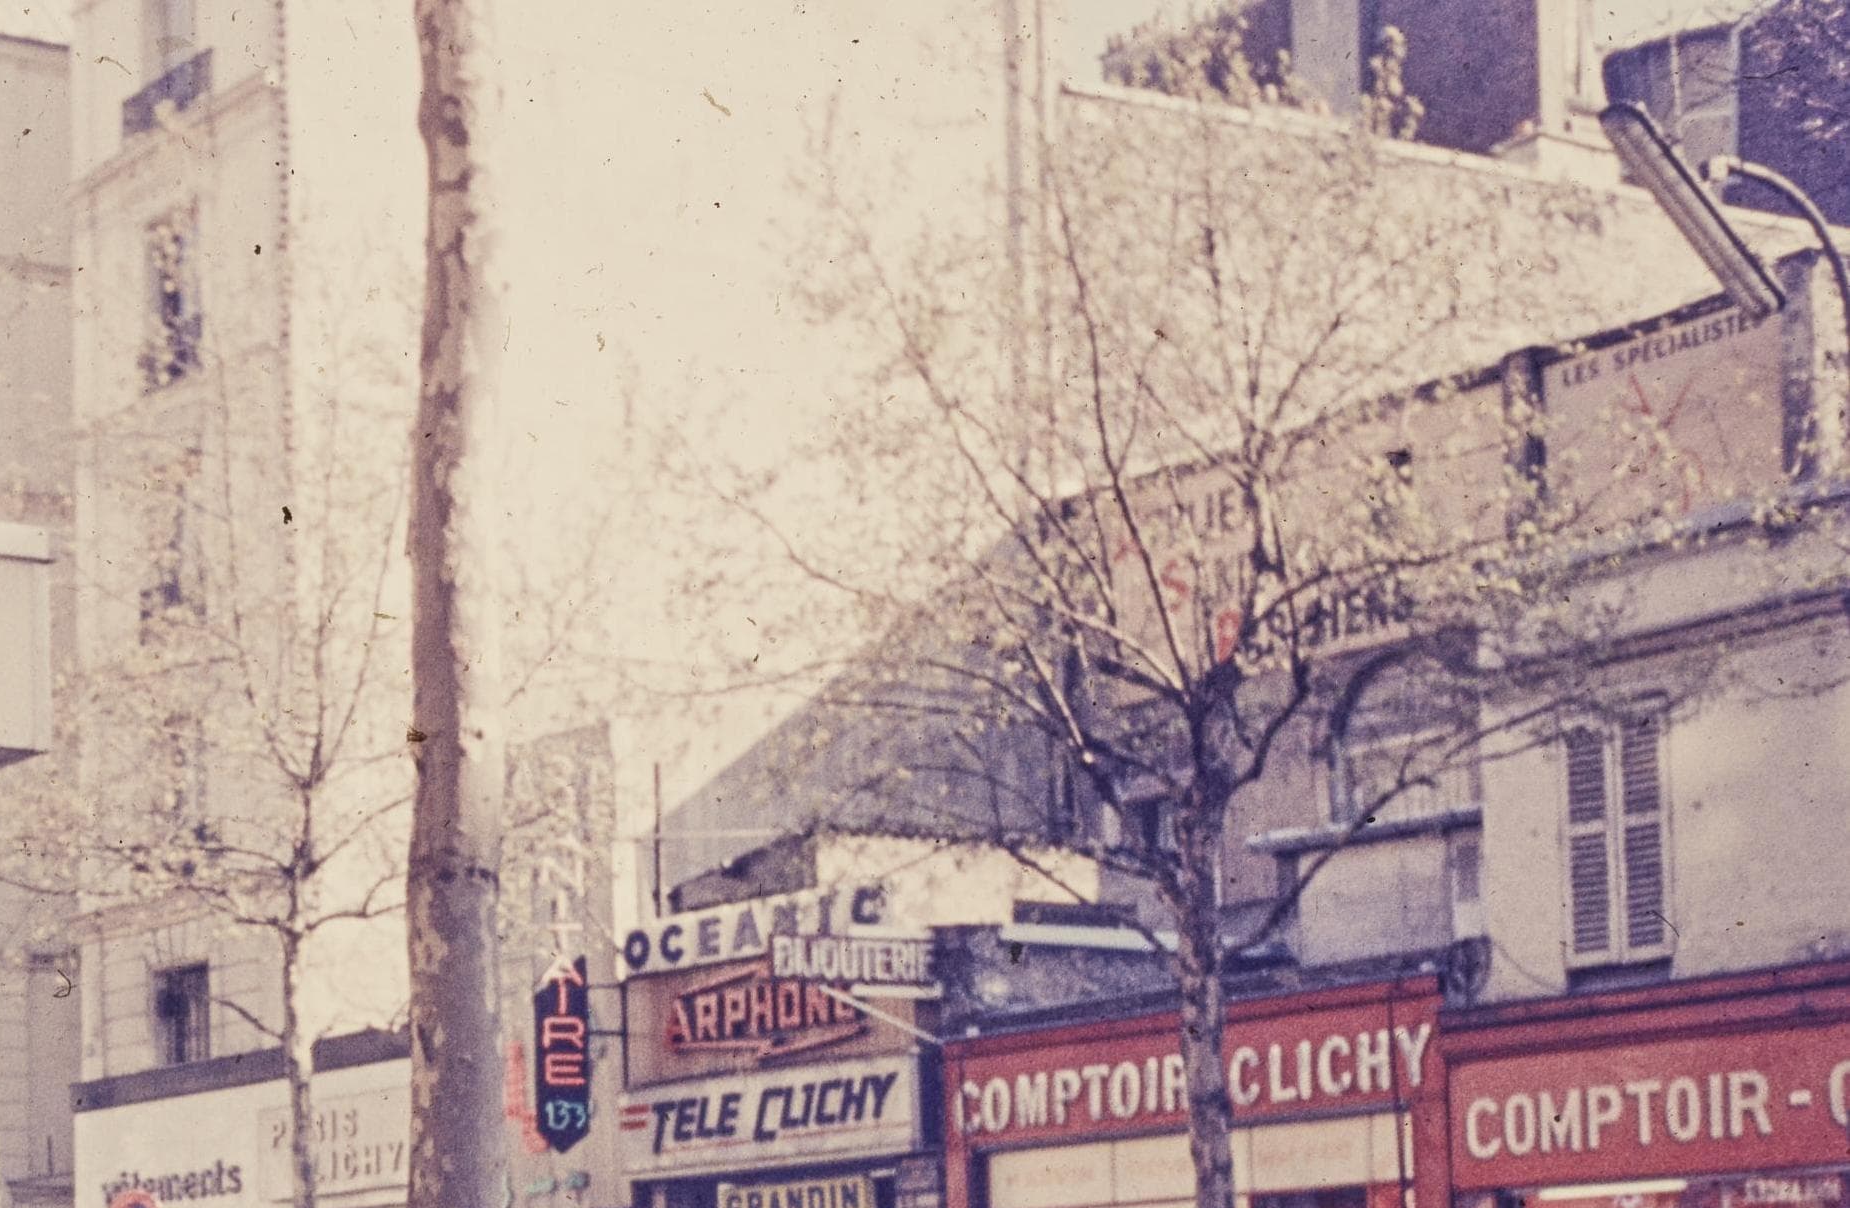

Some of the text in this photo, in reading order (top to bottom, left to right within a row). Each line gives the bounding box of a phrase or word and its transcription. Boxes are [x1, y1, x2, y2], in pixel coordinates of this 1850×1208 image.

[651, 1071, 899, 1155] TELE CLICHY
[954, 1023, 1432, 1134] COMPTOIR CLICHY
[1465, 1070, 1772, 1160] COMPTOIR
